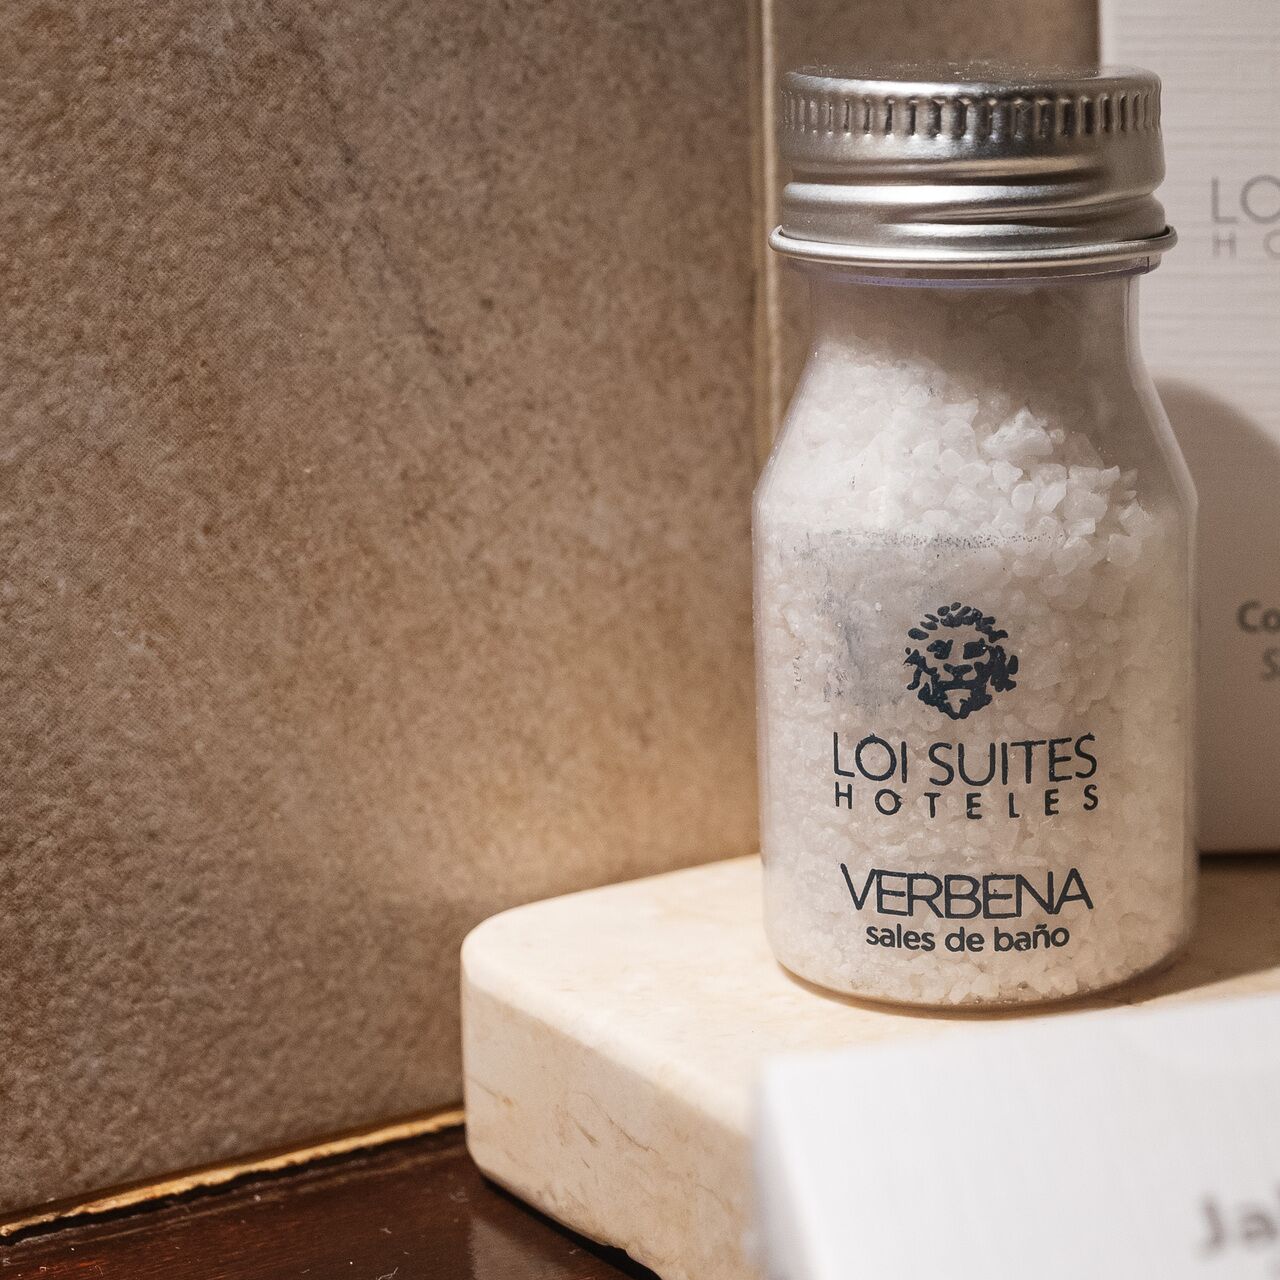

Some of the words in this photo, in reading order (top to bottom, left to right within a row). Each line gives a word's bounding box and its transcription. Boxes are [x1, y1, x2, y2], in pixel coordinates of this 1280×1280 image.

[833, 731, 908, 784] LOI
[928, 732, 1098, 786] SUITES
[834, 782, 1099, 820] HOTELES
[839, 862, 1094, 919] VERBENA
[865, 923, 936, 952] sales
[944, 926, 985, 953] de
[993, 923, 1070, 953] baño
